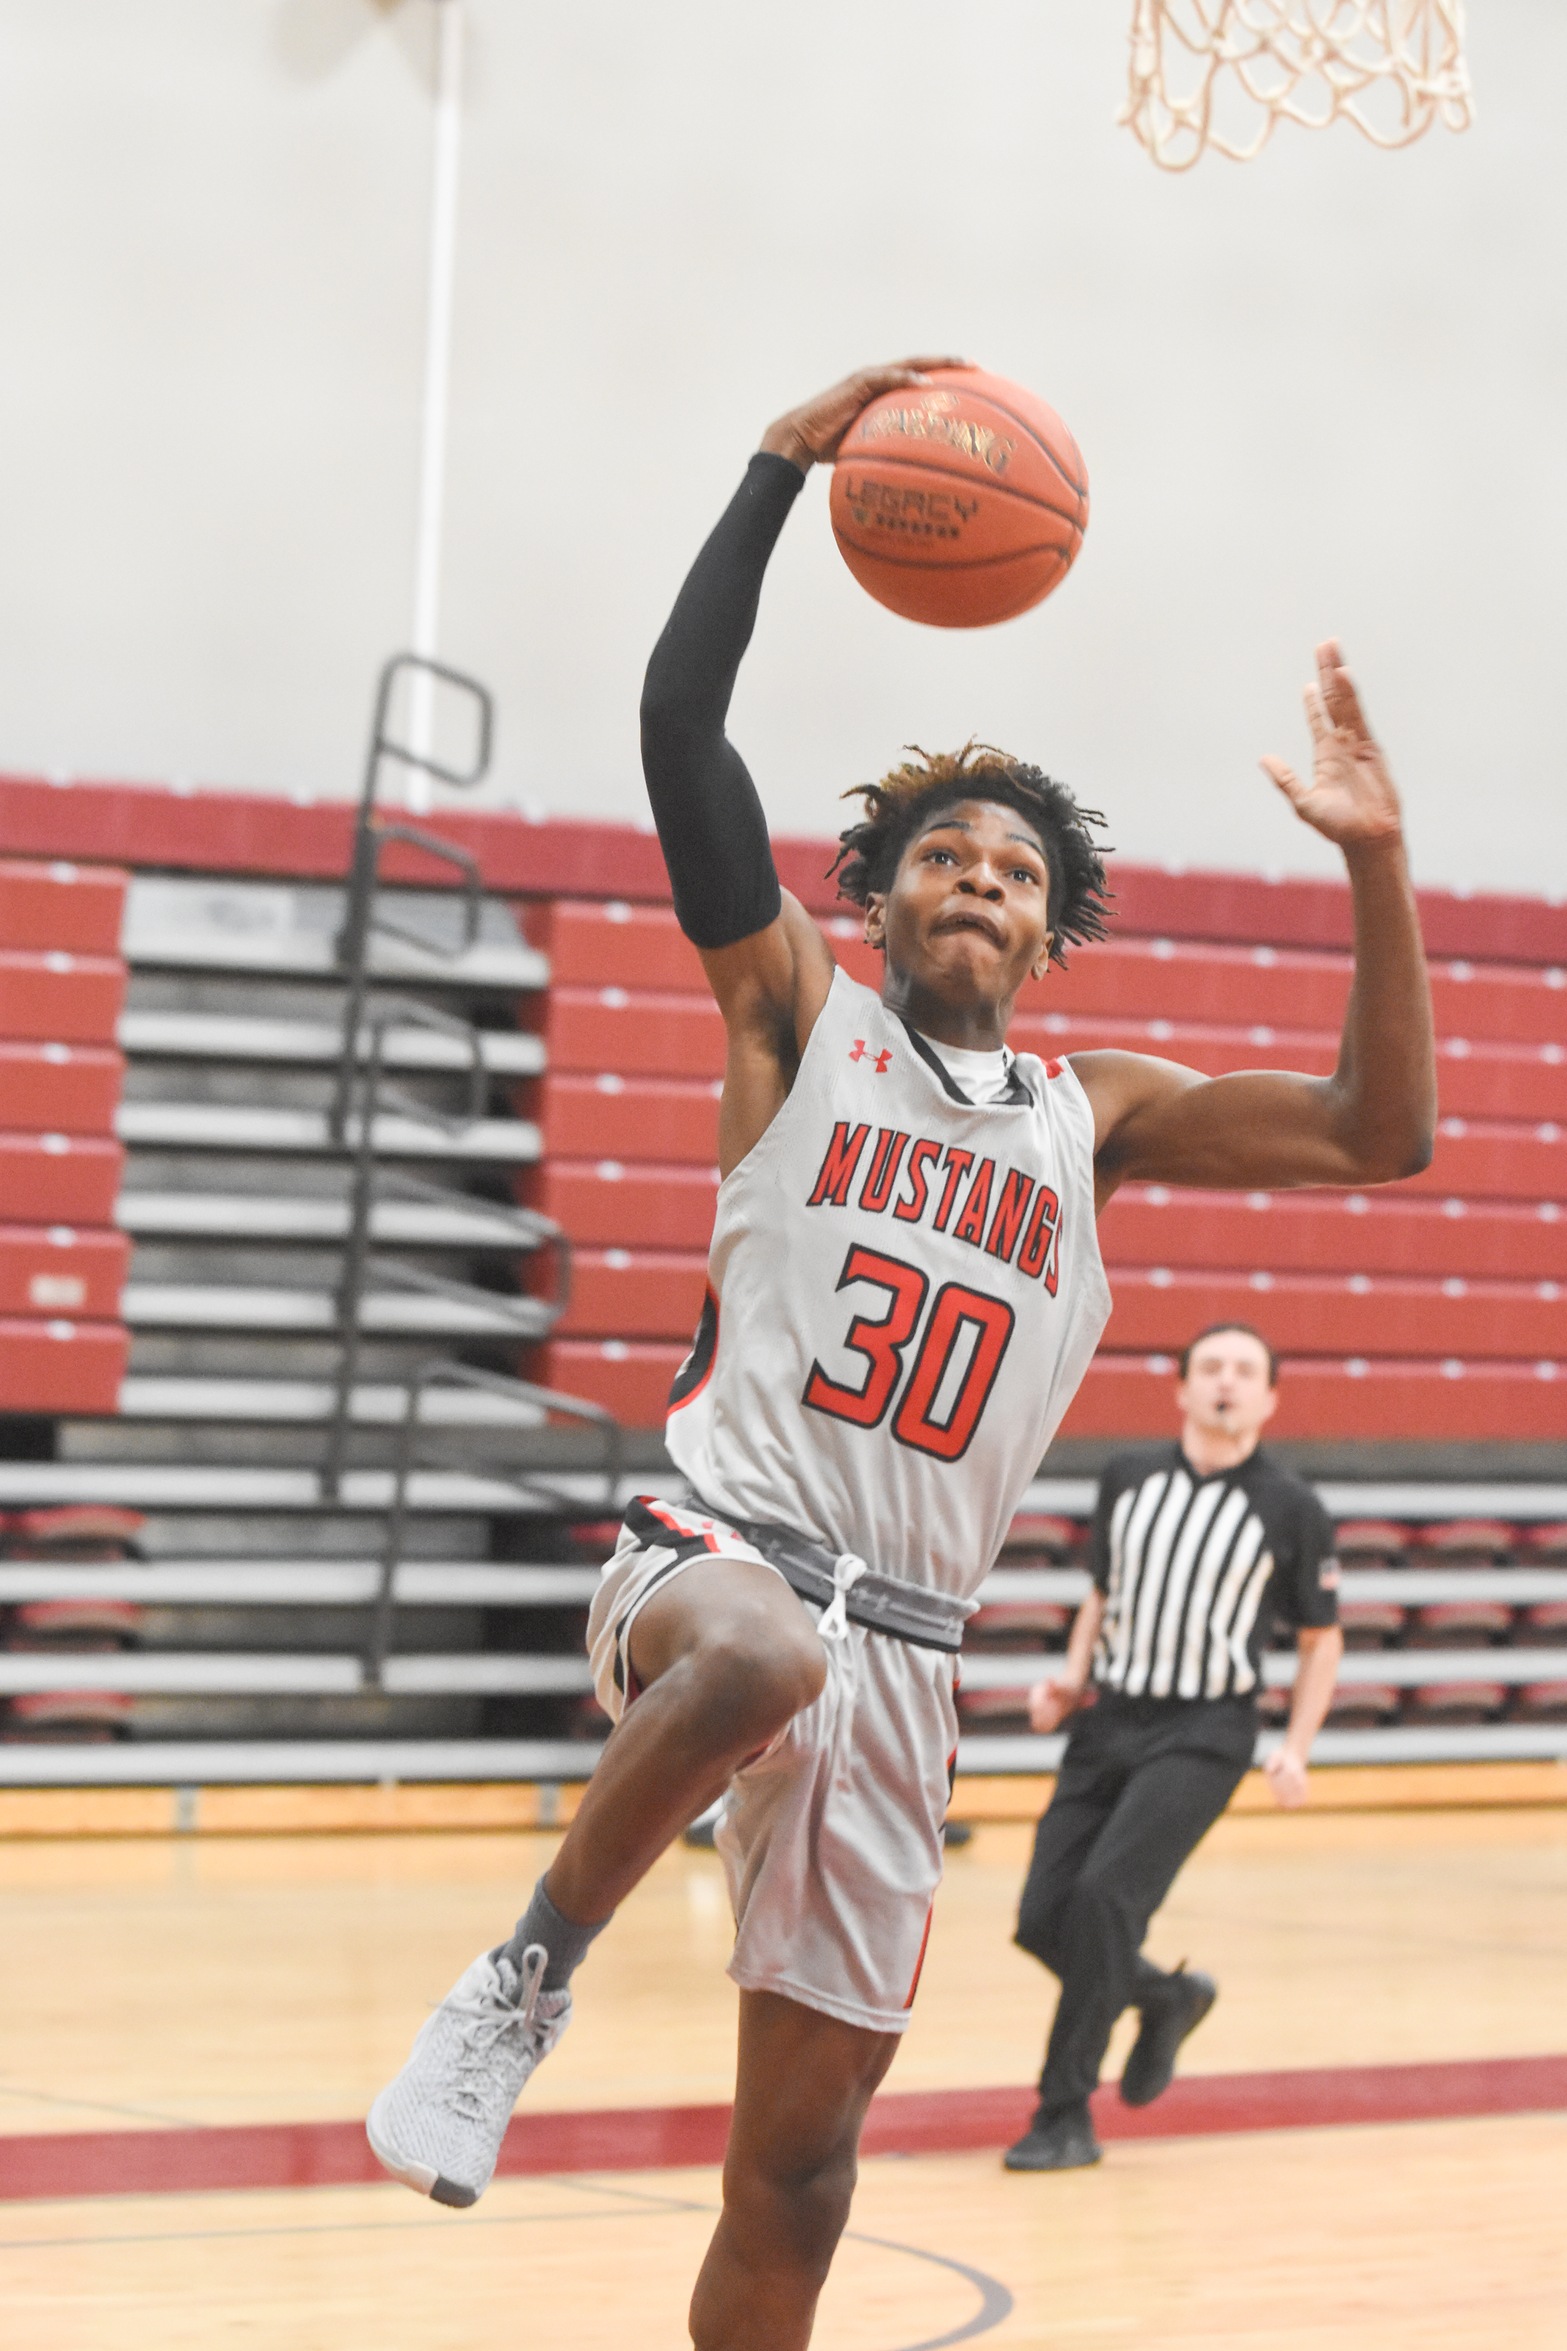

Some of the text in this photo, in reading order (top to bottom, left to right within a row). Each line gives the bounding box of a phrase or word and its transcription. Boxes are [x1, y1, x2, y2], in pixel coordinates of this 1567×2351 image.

[845, 475, 979, 523] LEGACY
[806, 1121, 1064, 1298] MUSTANGS
[802, 1242, 1015, 1463] 30
